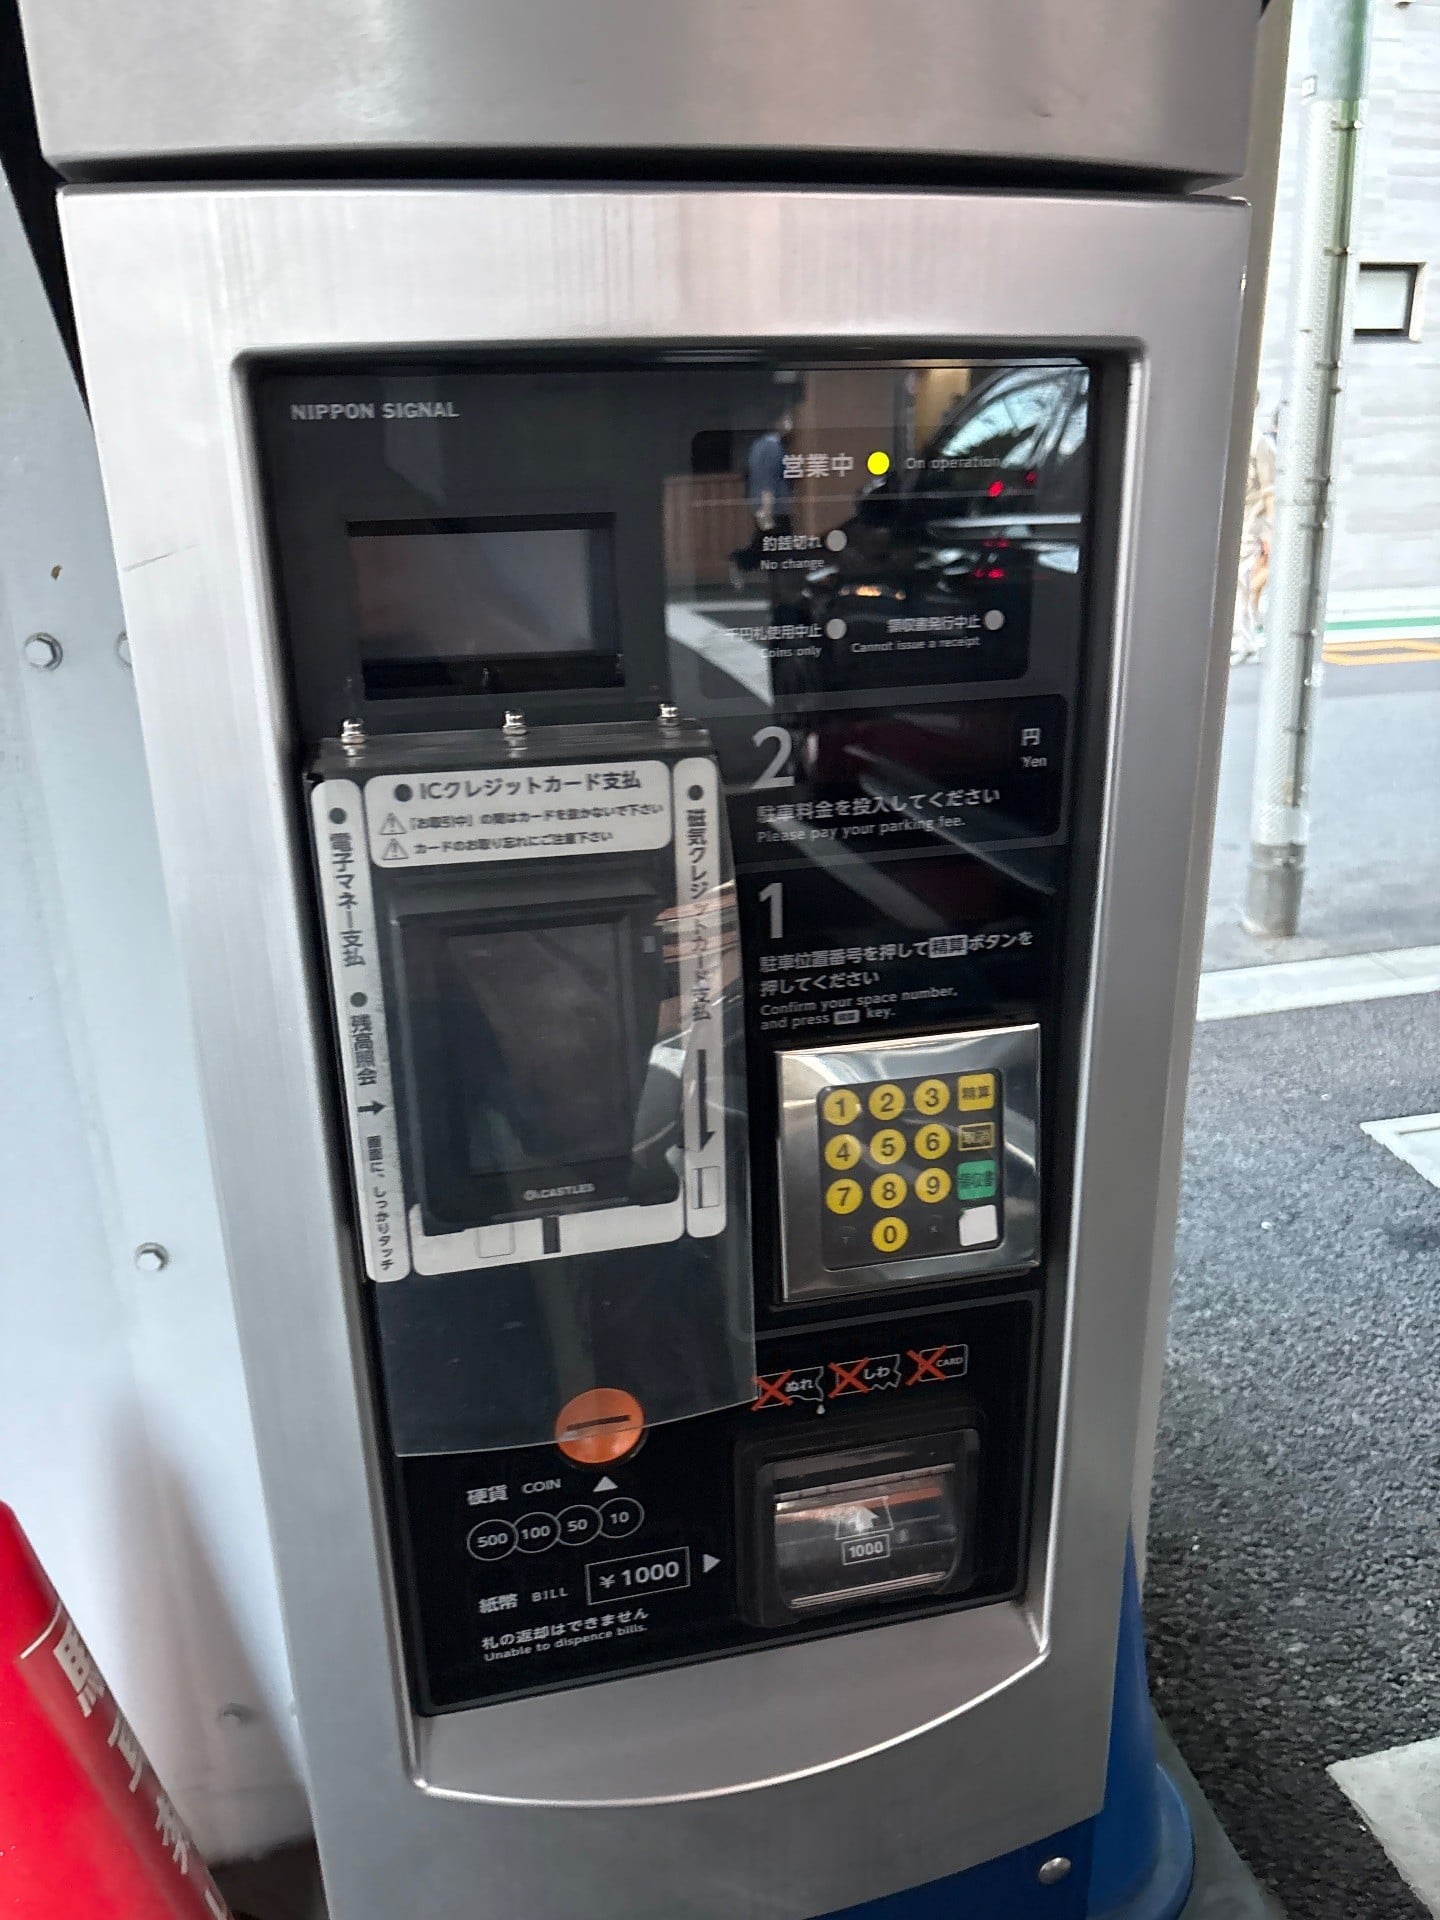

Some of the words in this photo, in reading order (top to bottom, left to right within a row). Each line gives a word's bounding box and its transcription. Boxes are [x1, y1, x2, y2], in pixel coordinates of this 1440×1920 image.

[291, 403, 375, 420] NIPPON
[382, 401, 460, 418] SIGNAL
[783, 454, 854, 479] 営業中
[907, 458, 928, 470] On
[931, 456, 1001, 472] operation
[760, 560, 778, 570] No
[782, 559, 824, 570] change
[761, 648, 792, 658] Coins
[796, 646, 822, 658] only
[851, 642, 893, 652] Cannot
[897, 641, 926, 650] issue
[928, 640, 936, 648] a
[938, 637, 980, 648] receipt
[1020, 727, 1041, 747] 円
[751, 726, 795, 789] 2
[1020, 755, 1047, 768] Yen
[420, 770, 641, 800] ICクレジットカード支払
[757, 788, 1000, 823] 駐車料金を投入してください
[757, 828, 805, 843] Please
[810, 828, 837, 842] pay
[843, 823, 876, 839] your
[879, 817, 934, 835] parking
[939, 814, 966, 828] fee.
[329, 833, 366, 967] 電子マネー支払
[759, 882, 783, 938] 1
[760, 970, 880, 997] 押してください
[760, 1001, 817, 1016] Confirm
[821, 998, 853, 1012] your
[856, 992, 898, 1007] space
[901, 987, 959, 1000] number.
[760, 1016, 787, 1030] and
[791, 1014, 830, 1029] press
[866, 1007, 896, 1021] key.
[835, 1099, 846, 1117] 1
[881, 1093, 894, 1112] 2
[925, 1088, 939, 1107] 3
[836, 1142, 850, 1162] 4
[882, 1137, 895, 1156] 5
[926, 1133, 940, 1151] 6
[541, 1183, 595, 1198] CASTLES
[837, 1187, 850, 1206] 7
[883, 1182, 896, 1200] 8
[926, 1176, 940, 1195] 9
[884, 1225, 897, 1244] 0
[864, 1366, 890, 1380] しわ
[936, 1357, 963, 1368] CARD
[786, 1380, 814, 1392] ぬれ
[466, 1485, 508, 1506] 硬貨
[521, 1478, 561, 1494] COIN
[477, 1532, 508, 1548] 500
[520, 1525, 551, 1540] 100
[567, 1518, 588, 1532] 50
[610, 1511, 629, 1524] 10
[849, 1541, 883, 1558] 1000
[478, 1593, 518, 1614] 紙幣
[531, 1587, 568, 1602] BILL
[482, 1608, 649, 1650] 札の返却はできません
[484, 1645, 532, 1662] Unable
[536, 1640, 550, 1652] to
[554, 1630, 612, 1649] dispence
[616, 1623, 648, 1637] bills.
